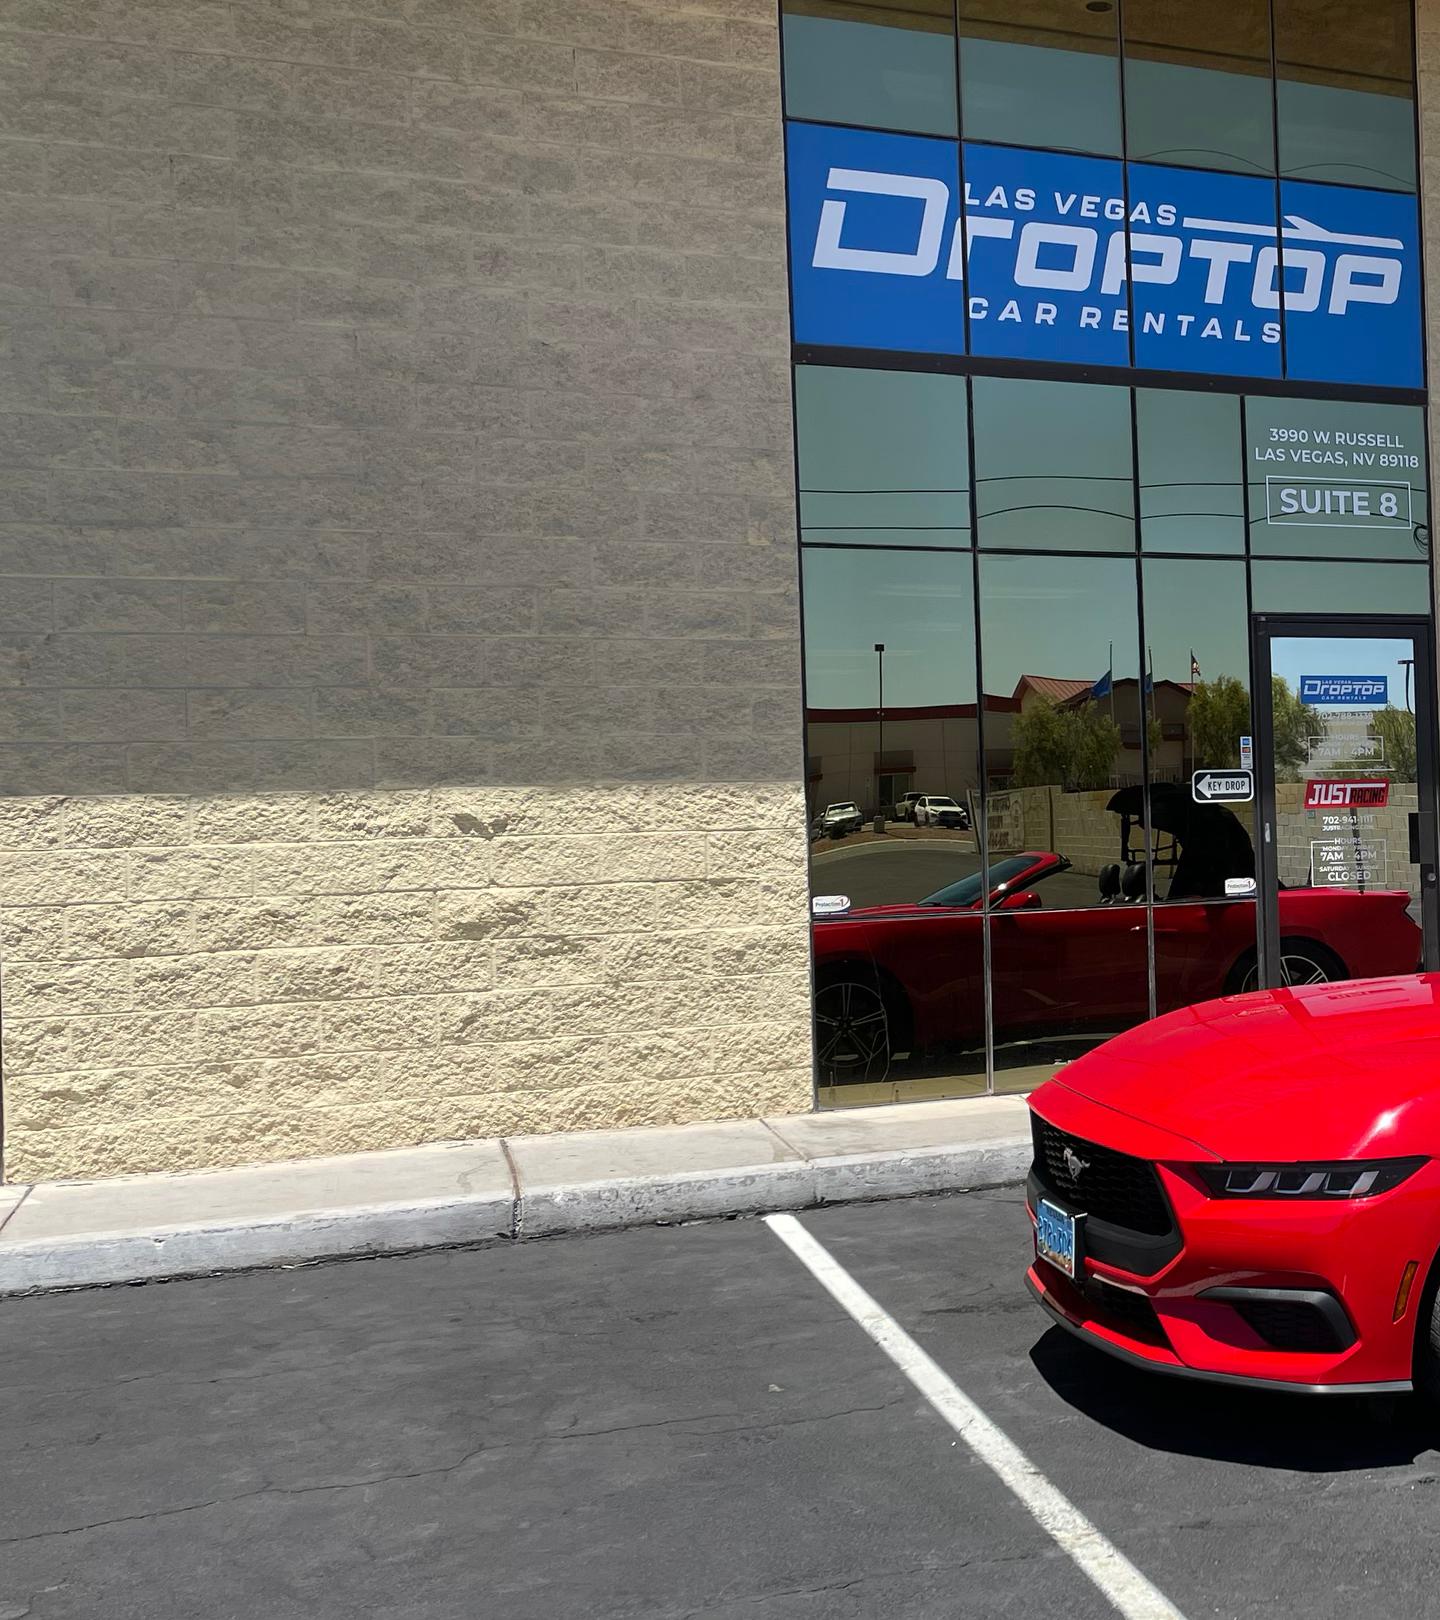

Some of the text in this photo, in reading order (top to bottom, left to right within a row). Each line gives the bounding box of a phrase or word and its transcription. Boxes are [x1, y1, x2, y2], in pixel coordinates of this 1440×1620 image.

[964, 182, 1177, 227] LAS VEGAS
[969, 297, 1282, 343] CAR RENTALS
[1269, 428, 1308, 443] 3990
[1335, 432, 1404, 448] RUSSELL
[1255, 447, 1419, 468] LAS VEGAS, NV 89118
[1280, 488, 1398, 517] SUITE 8
[1319, 748, 1341, 756] 7AM
[1352, 747, 1374, 756] 4PM
[1207, 780, 1246, 791] KEY DROP
[1308, 783, 1385, 805] JUST RACING
[1334, 837, 1361, 845] HOURS
[1320, 852, 1344, 861] 7AM
[1354, 851, 1377, 860] 4PM
[1328, 871, 1371, 881] CLOSED
